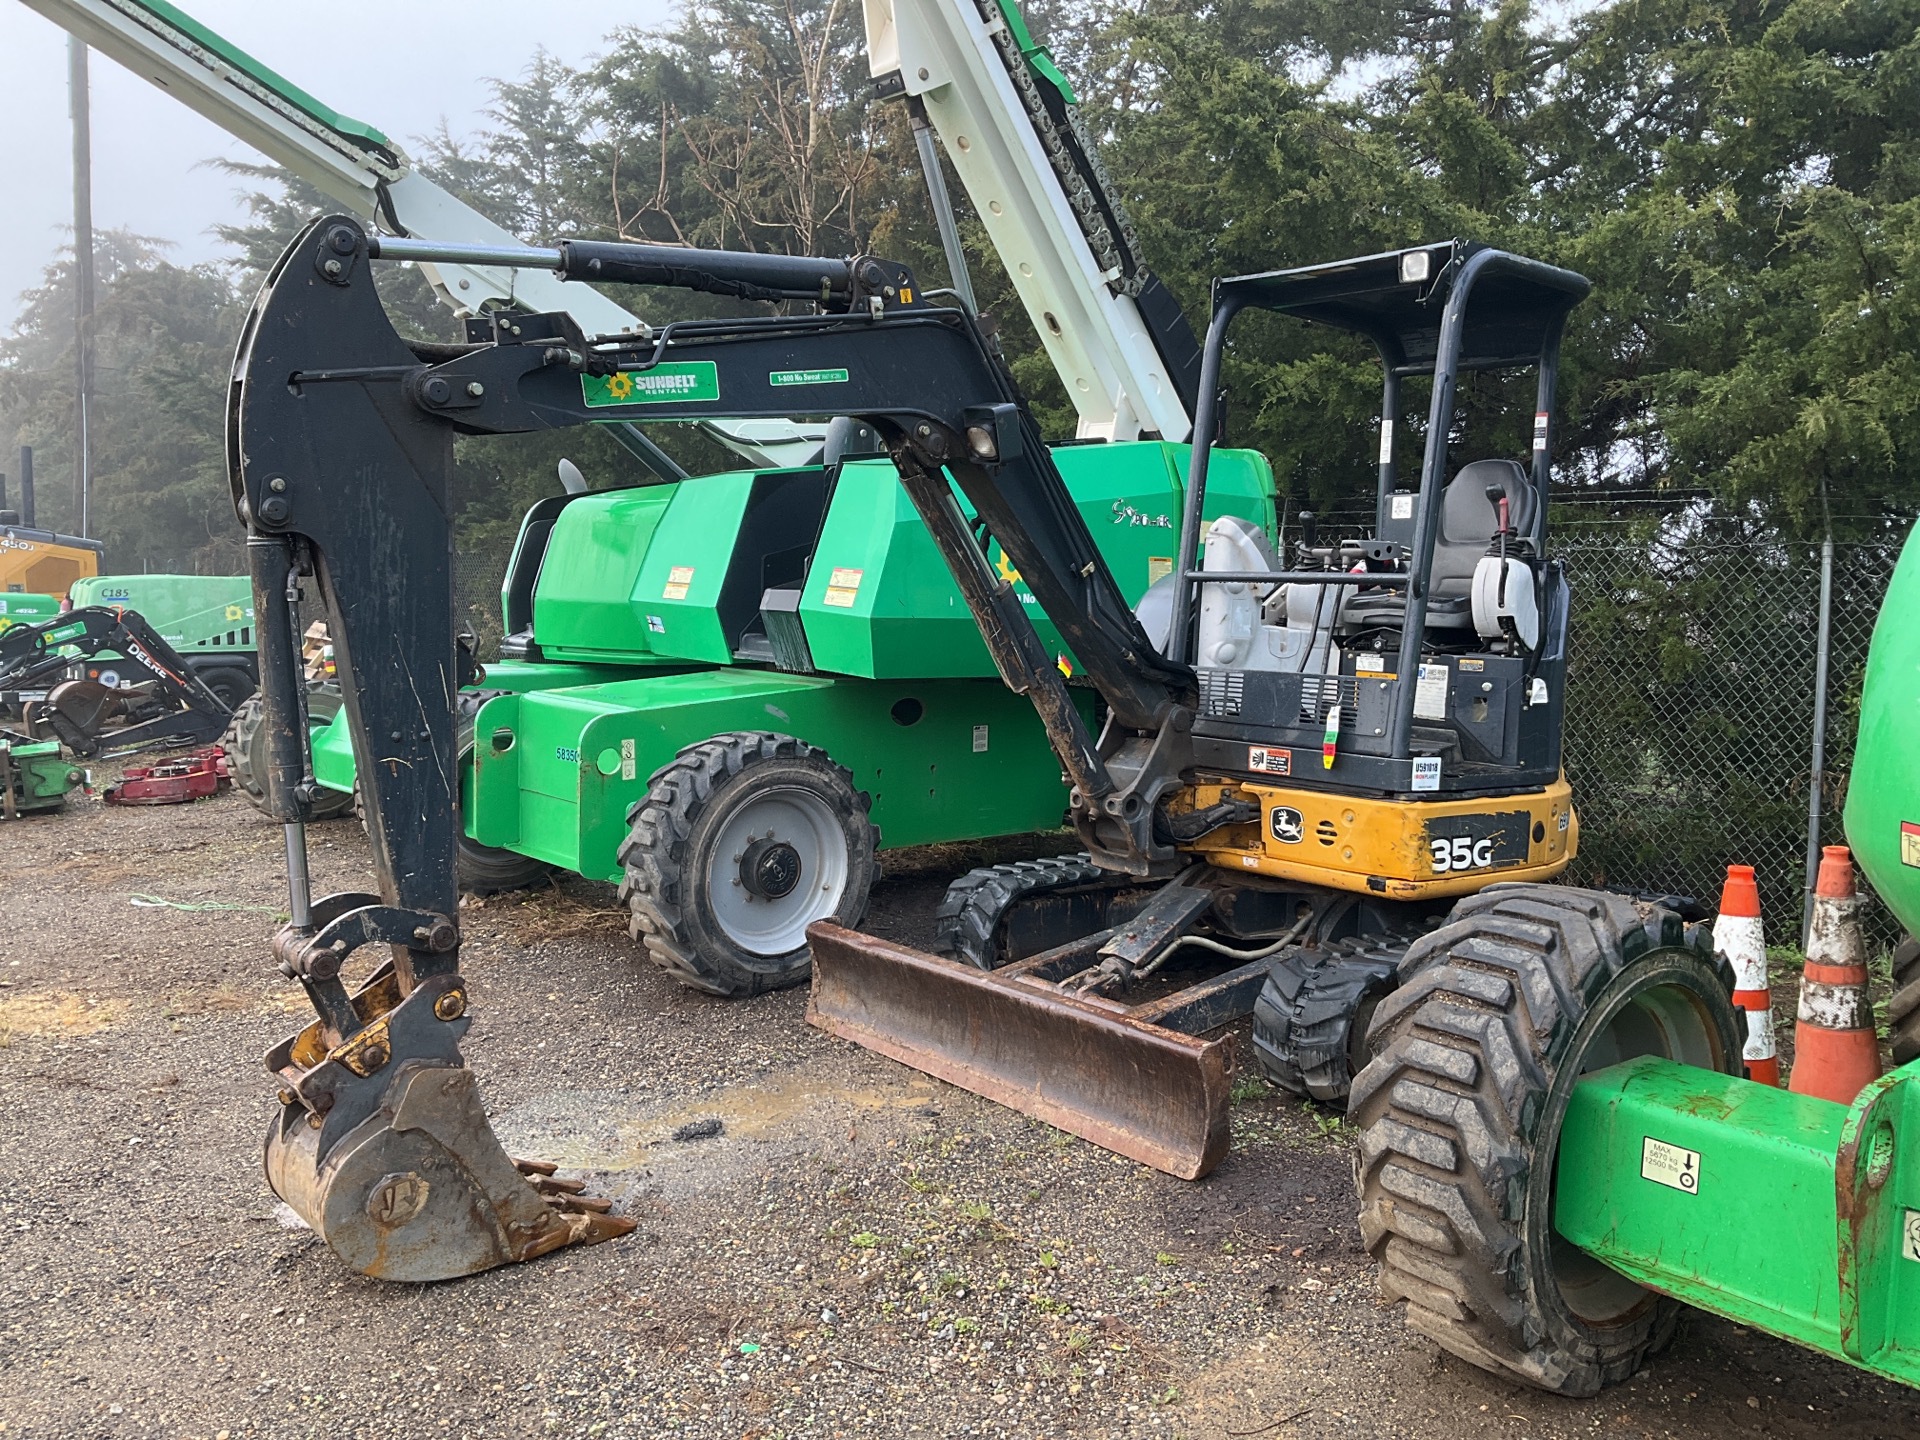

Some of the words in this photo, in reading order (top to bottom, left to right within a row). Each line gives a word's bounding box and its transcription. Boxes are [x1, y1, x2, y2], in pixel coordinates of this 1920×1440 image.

[635, 375, 696, 390] SUNBELT
[794, 374, 803, 382] No
[803, 373, 821, 381] Sweat
[645, 387, 689, 395] RENTALS
[101, 588, 129, 598] C185
[1023, 593, 1036, 604] No
[126, 642, 167, 679] DEERE
[1430, 836, 1492, 872] 35G
[1653, 1143, 1671, 1154] MAX
[1645, 1156, 1667, 1169] 12500
[1668, 1163, 1679, 1173] lbs
[1650, 1149, 1668, 1161] 5670
[1669, 1157, 1678, 1167] kg
